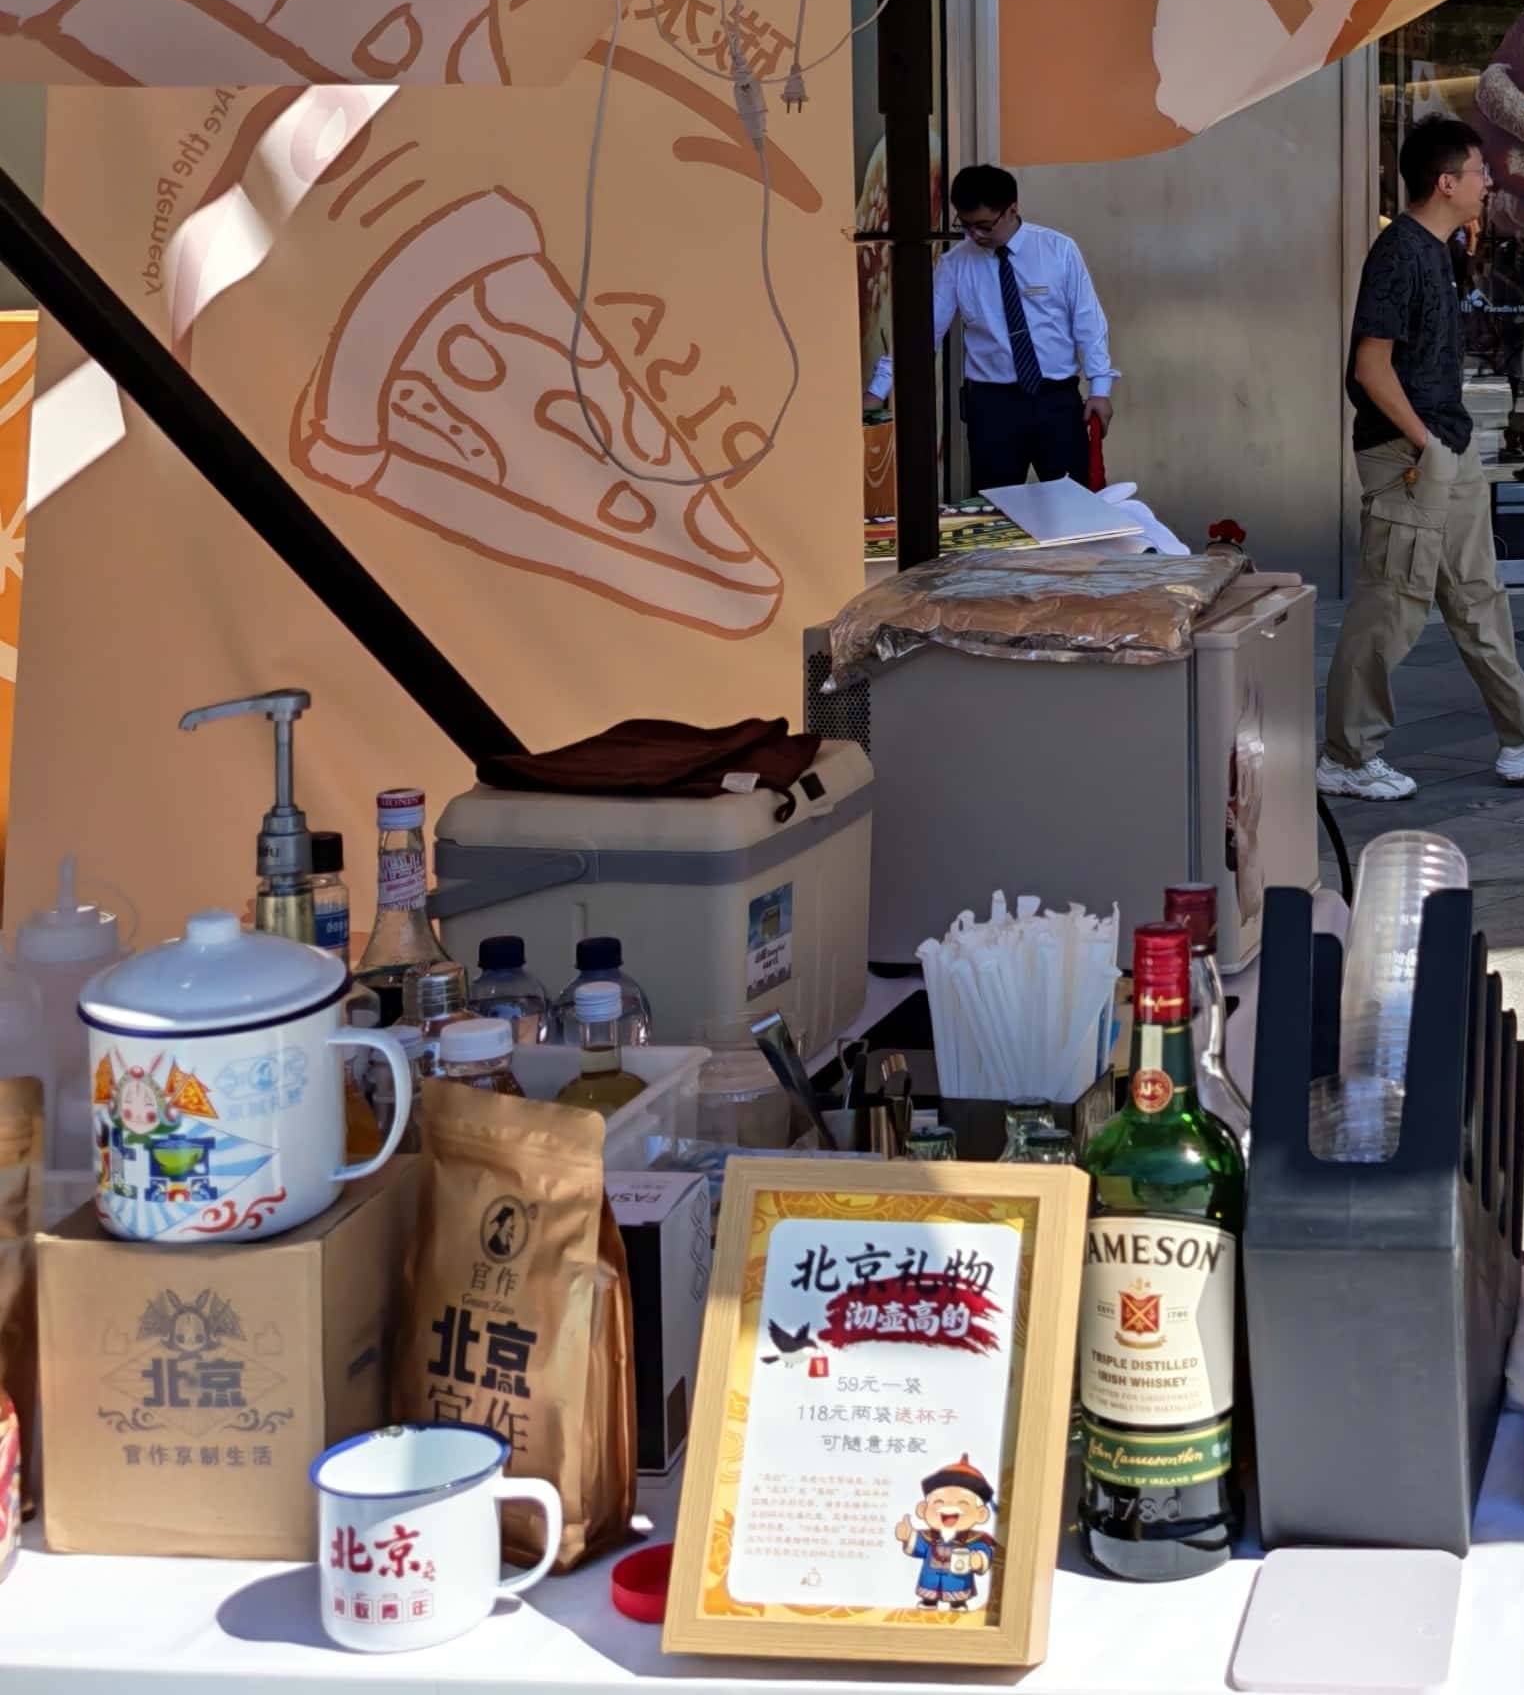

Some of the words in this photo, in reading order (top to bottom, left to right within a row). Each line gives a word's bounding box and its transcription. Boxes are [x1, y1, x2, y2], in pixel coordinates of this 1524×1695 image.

[792, 1243, 995, 1298] 北京礼物
[1084, 1231, 1222, 1275] AMESON
[844, 1301, 971, 1338] 沏壶高的
[428, 1305, 537, 1398] 北京
[1131, 1357, 1198, 1372] DISTILLED
[141, 1358, 247, 1408] 北京
[837, 1375, 922, 1395] 59元一袋
[1098, 1371, 1126, 1386] IRISH
[1129, 1376, 1188, 1388] WHISKEY
[798, 1403, 958, 1424] 118元两袋送杯子
[821, 1434, 928, 1455] 可随意搭配
[331, 1524, 420, 1578] 北京
